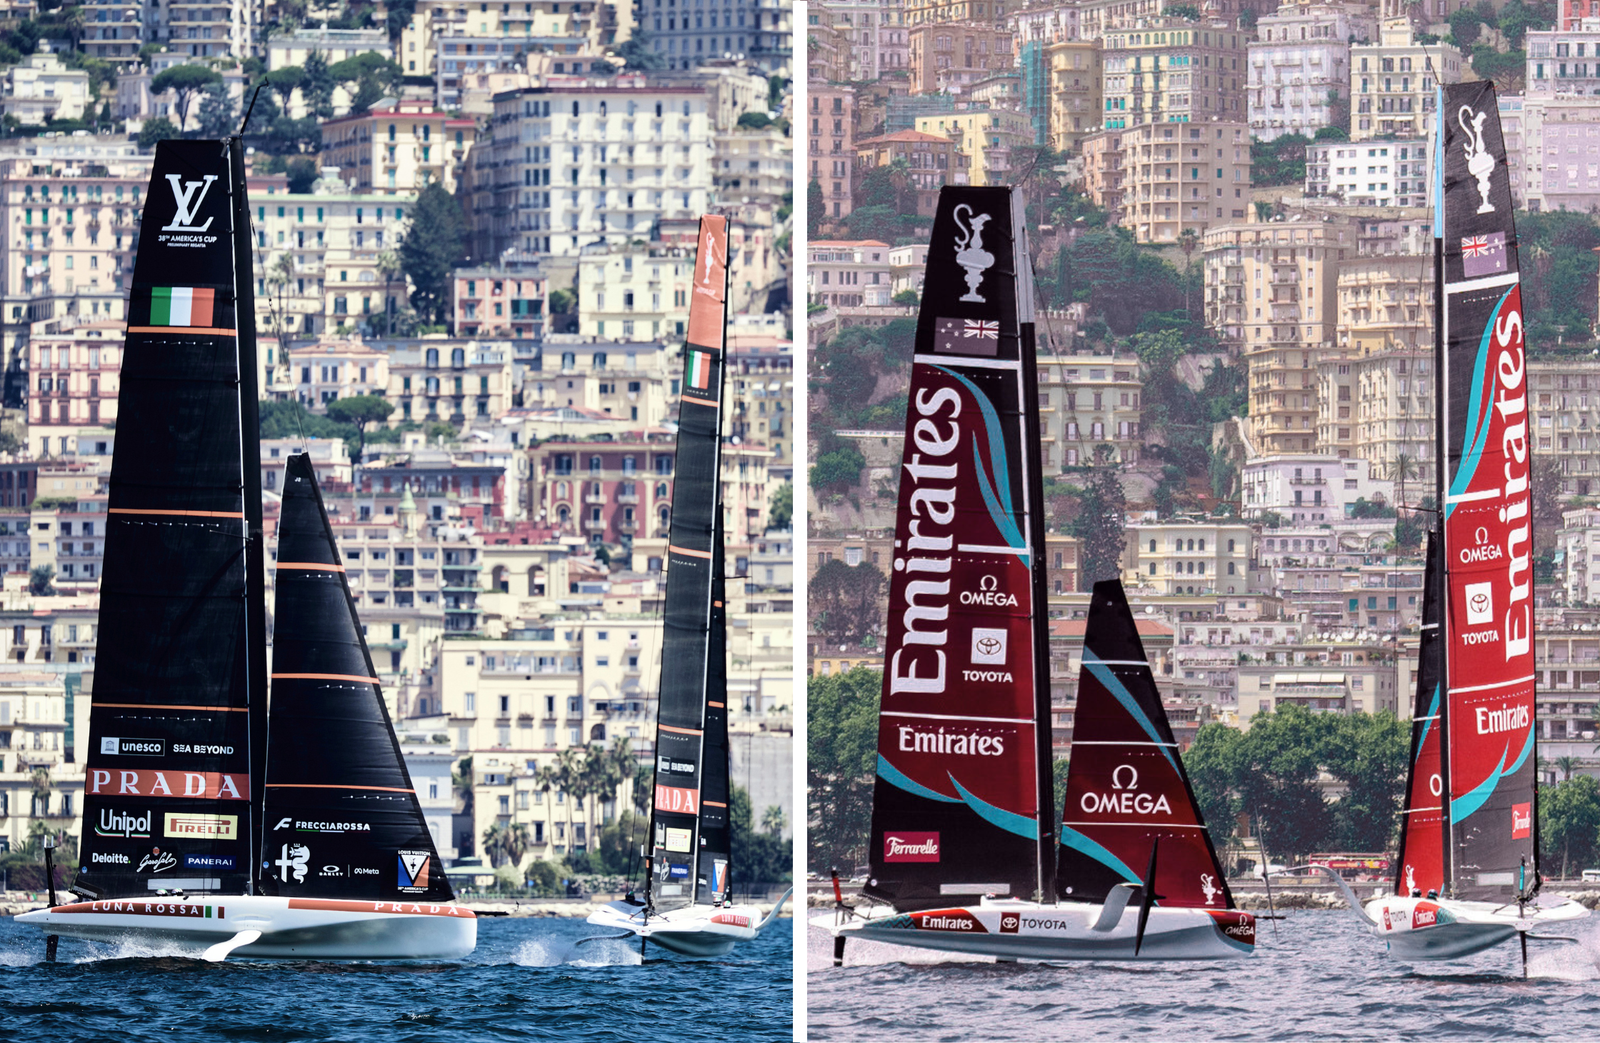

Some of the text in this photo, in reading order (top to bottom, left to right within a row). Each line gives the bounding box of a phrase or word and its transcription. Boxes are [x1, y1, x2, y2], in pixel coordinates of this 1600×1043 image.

[1495, 310, 1529, 663] Emirates
[890, 387, 962, 696] Emirates
[1459, 544, 1503, 563] OMEGA
[959, 591, 1018, 607] OMEGA
[1461, 630, 1499, 645] TOYOTA
[962, 670, 1013, 683] TOYOTA
[1475, 703, 1529, 735] Emirates
[122, 742, 161, 752] unesco
[899, 726, 1004, 756] Emirates
[173, 744, 234, 755] SEA BEYOND
[91, 770, 242, 798] PRADA
[656, 786, 695, 812] PRADA
[1080, 792, 1172, 815] OMEGA
[101, 808, 151, 838] Unipol
[170, 818, 231, 834] PIRELLI
[295, 821, 371, 831] FRECCIAROSSA
[886, 836, 938, 857] Ferrarelle
[188, 858, 232, 866] PANERAI
[92, 902, 199, 915] LUNA ROSSA
[374, 902, 459, 915] PRADA
[922, 915, 973, 930] Emirates
[1021, 918, 1067, 930] TOYOTA
[1225, 926, 1254, 935] OMEGA
